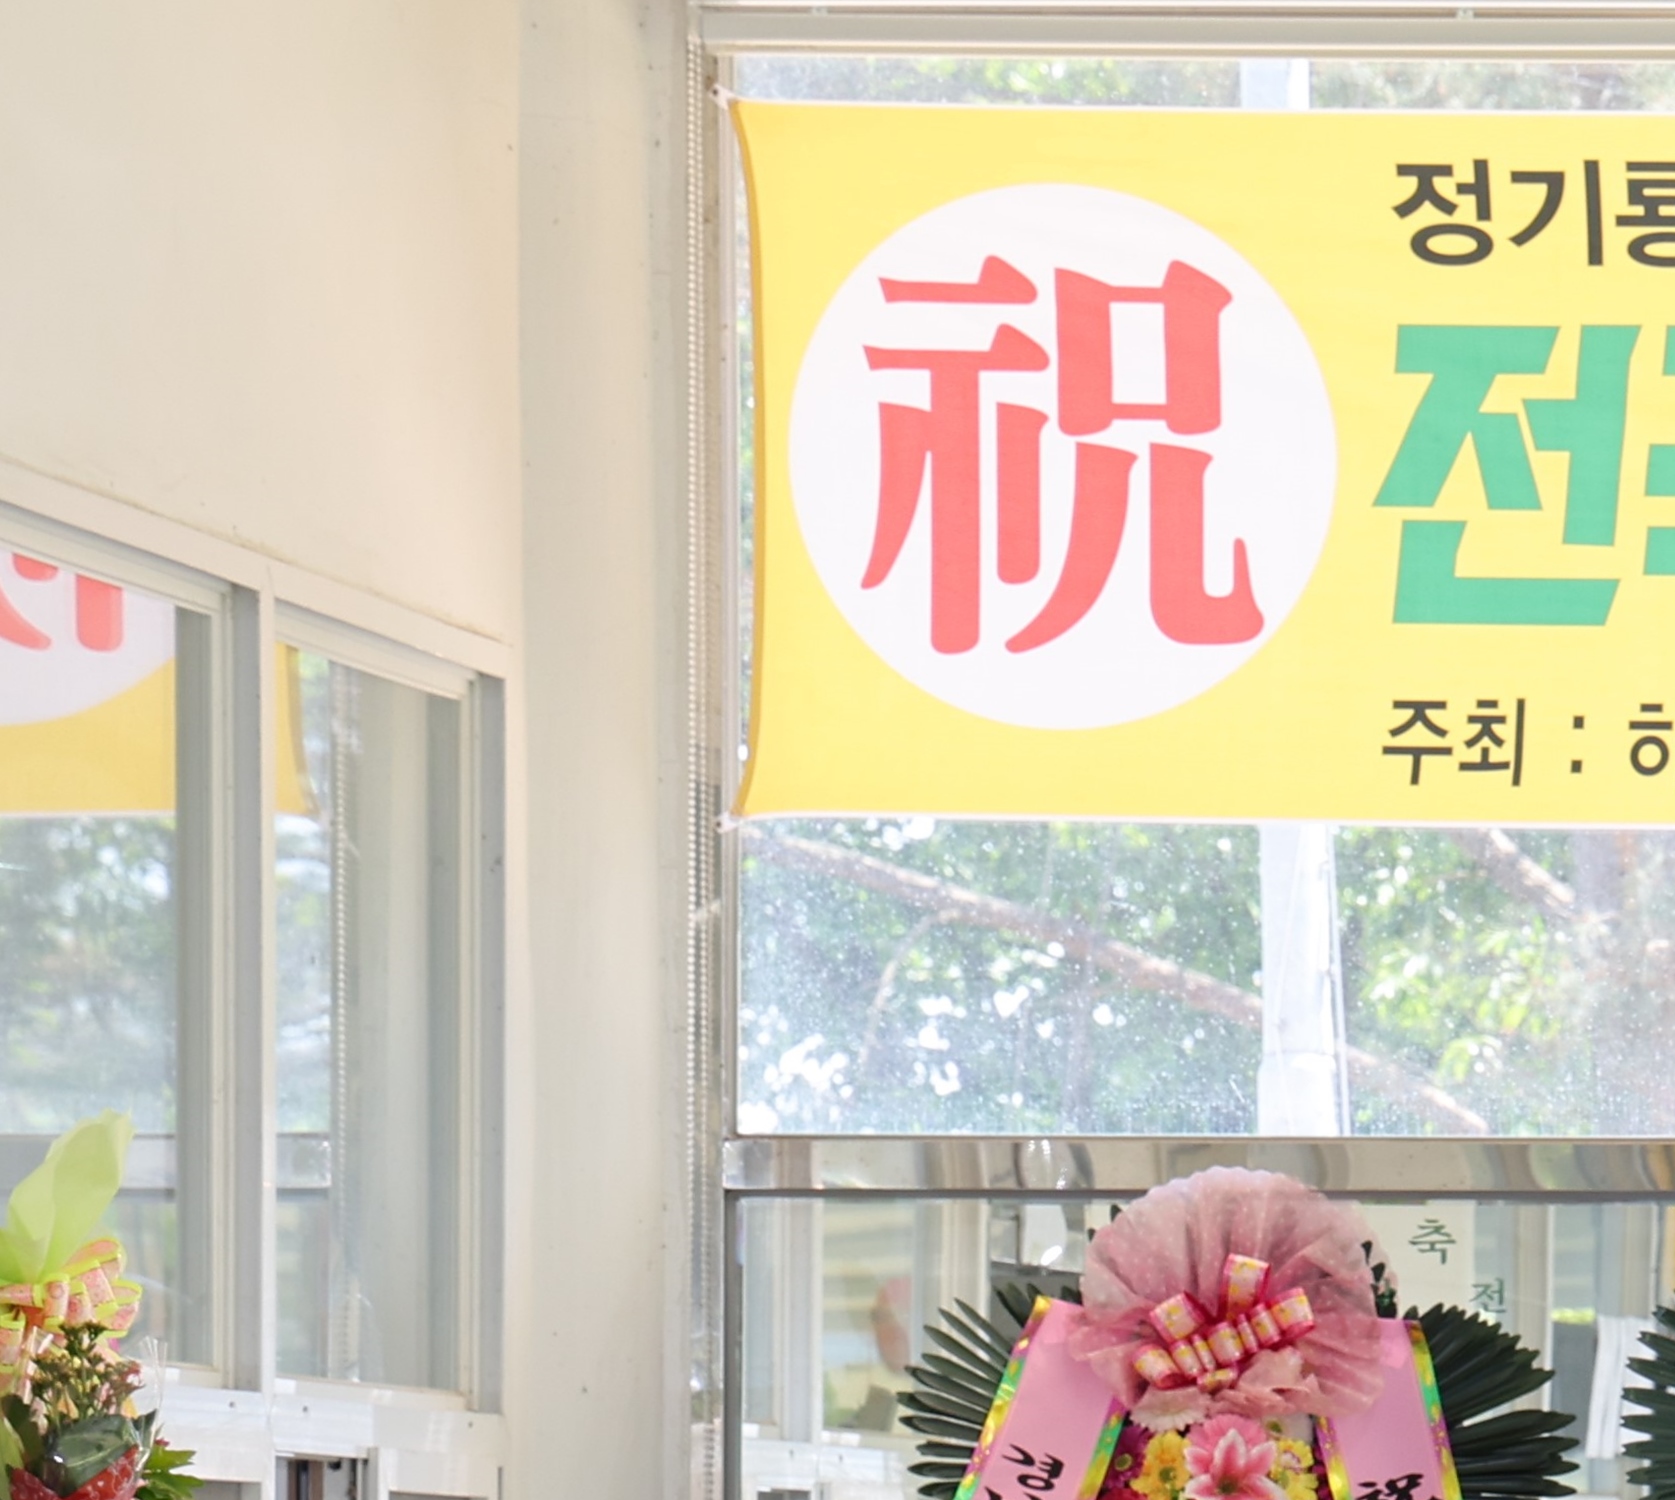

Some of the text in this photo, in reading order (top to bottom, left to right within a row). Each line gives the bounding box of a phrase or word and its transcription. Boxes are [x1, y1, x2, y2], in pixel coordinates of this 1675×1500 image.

[862, 254, 1266, 655] 祝
[1381, 699, 1527, 788] 주최
[1408, 1218, 1456, 1266] 축
